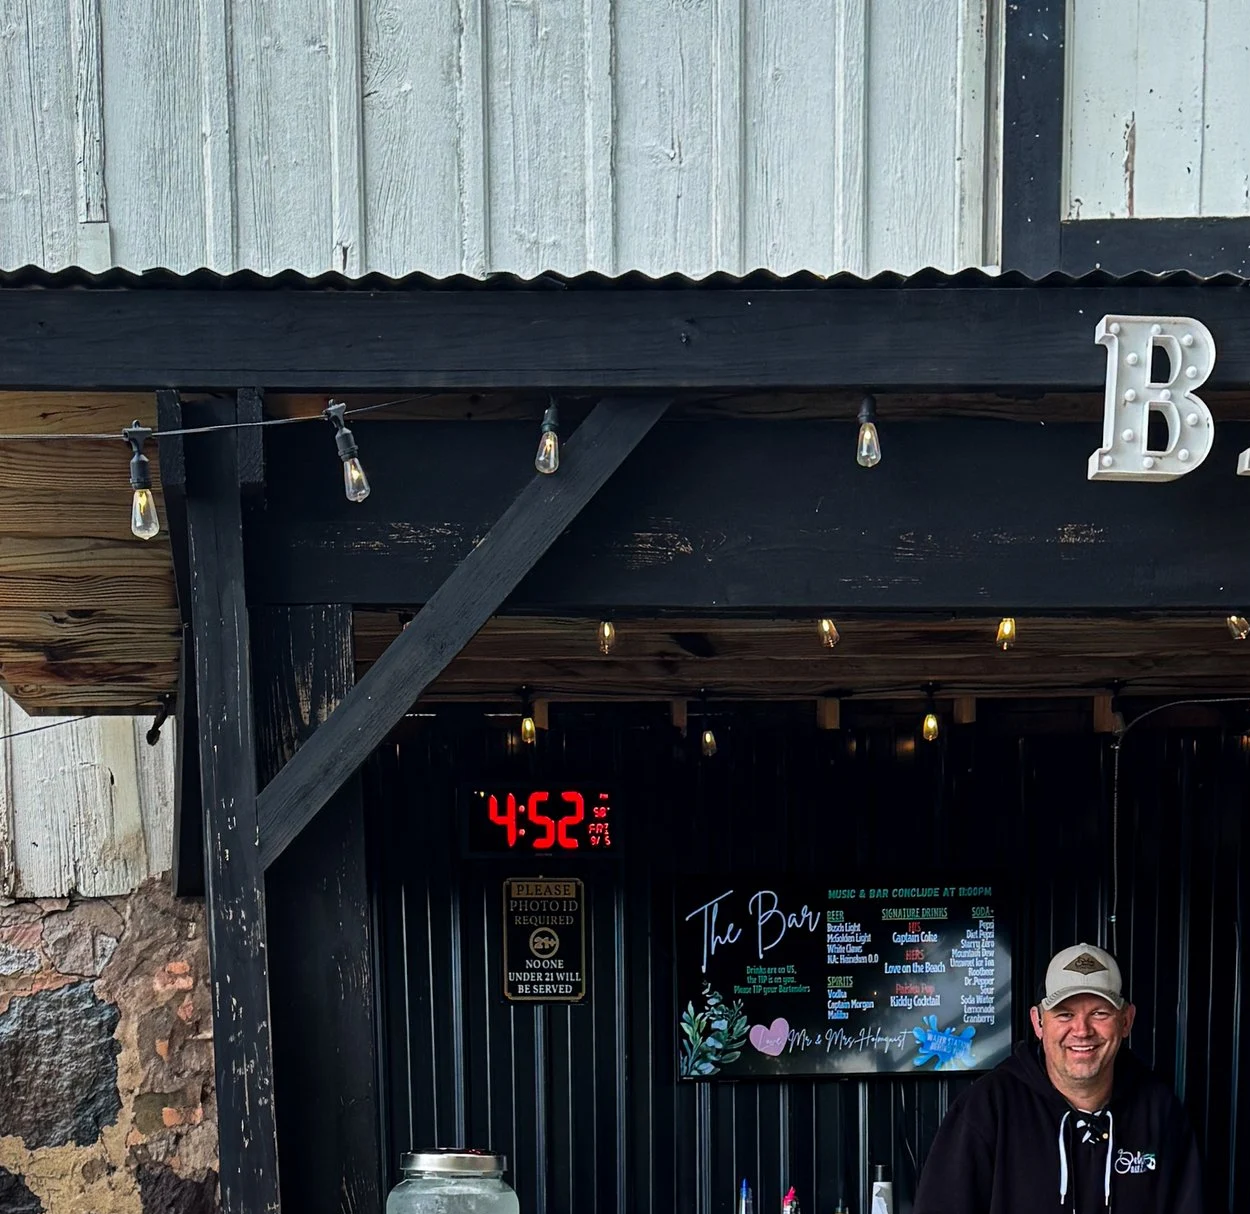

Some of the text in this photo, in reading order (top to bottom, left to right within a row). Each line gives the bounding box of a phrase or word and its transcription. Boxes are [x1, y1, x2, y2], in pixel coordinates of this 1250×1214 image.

[488, 791, 584, 848] 4:52
[515, 883, 571, 896] PLEASE
[828, 889, 856, 899] MUSIC
[858, 889, 866, 898] &
[869, 888, 889, 898] BAR
[892, 887, 940, 898] CONCLUDE
[942, 887, 956, 897] AT
[509, 900, 578, 912] PHOTO ID
[882, 907, 948, 919] SIGNATURE DRINKS
[514, 915, 574, 926] REQUIRED
[686, 889, 820, 973] The Bar
[533, 936, 557, 949] 21+
[892, 931, 920, 945] Captain
[525, 959, 564, 969] NO ONE
[884, 962, 901, 974] Love
[912, 962, 924, 973] the
[508, 971, 582, 982] UNDER 21 WILL
[827, 976, 853, 987] SPIRITS
[517, 984, 573, 994] BE SERVED
[963, 1014, 994, 1025] Cranberry
